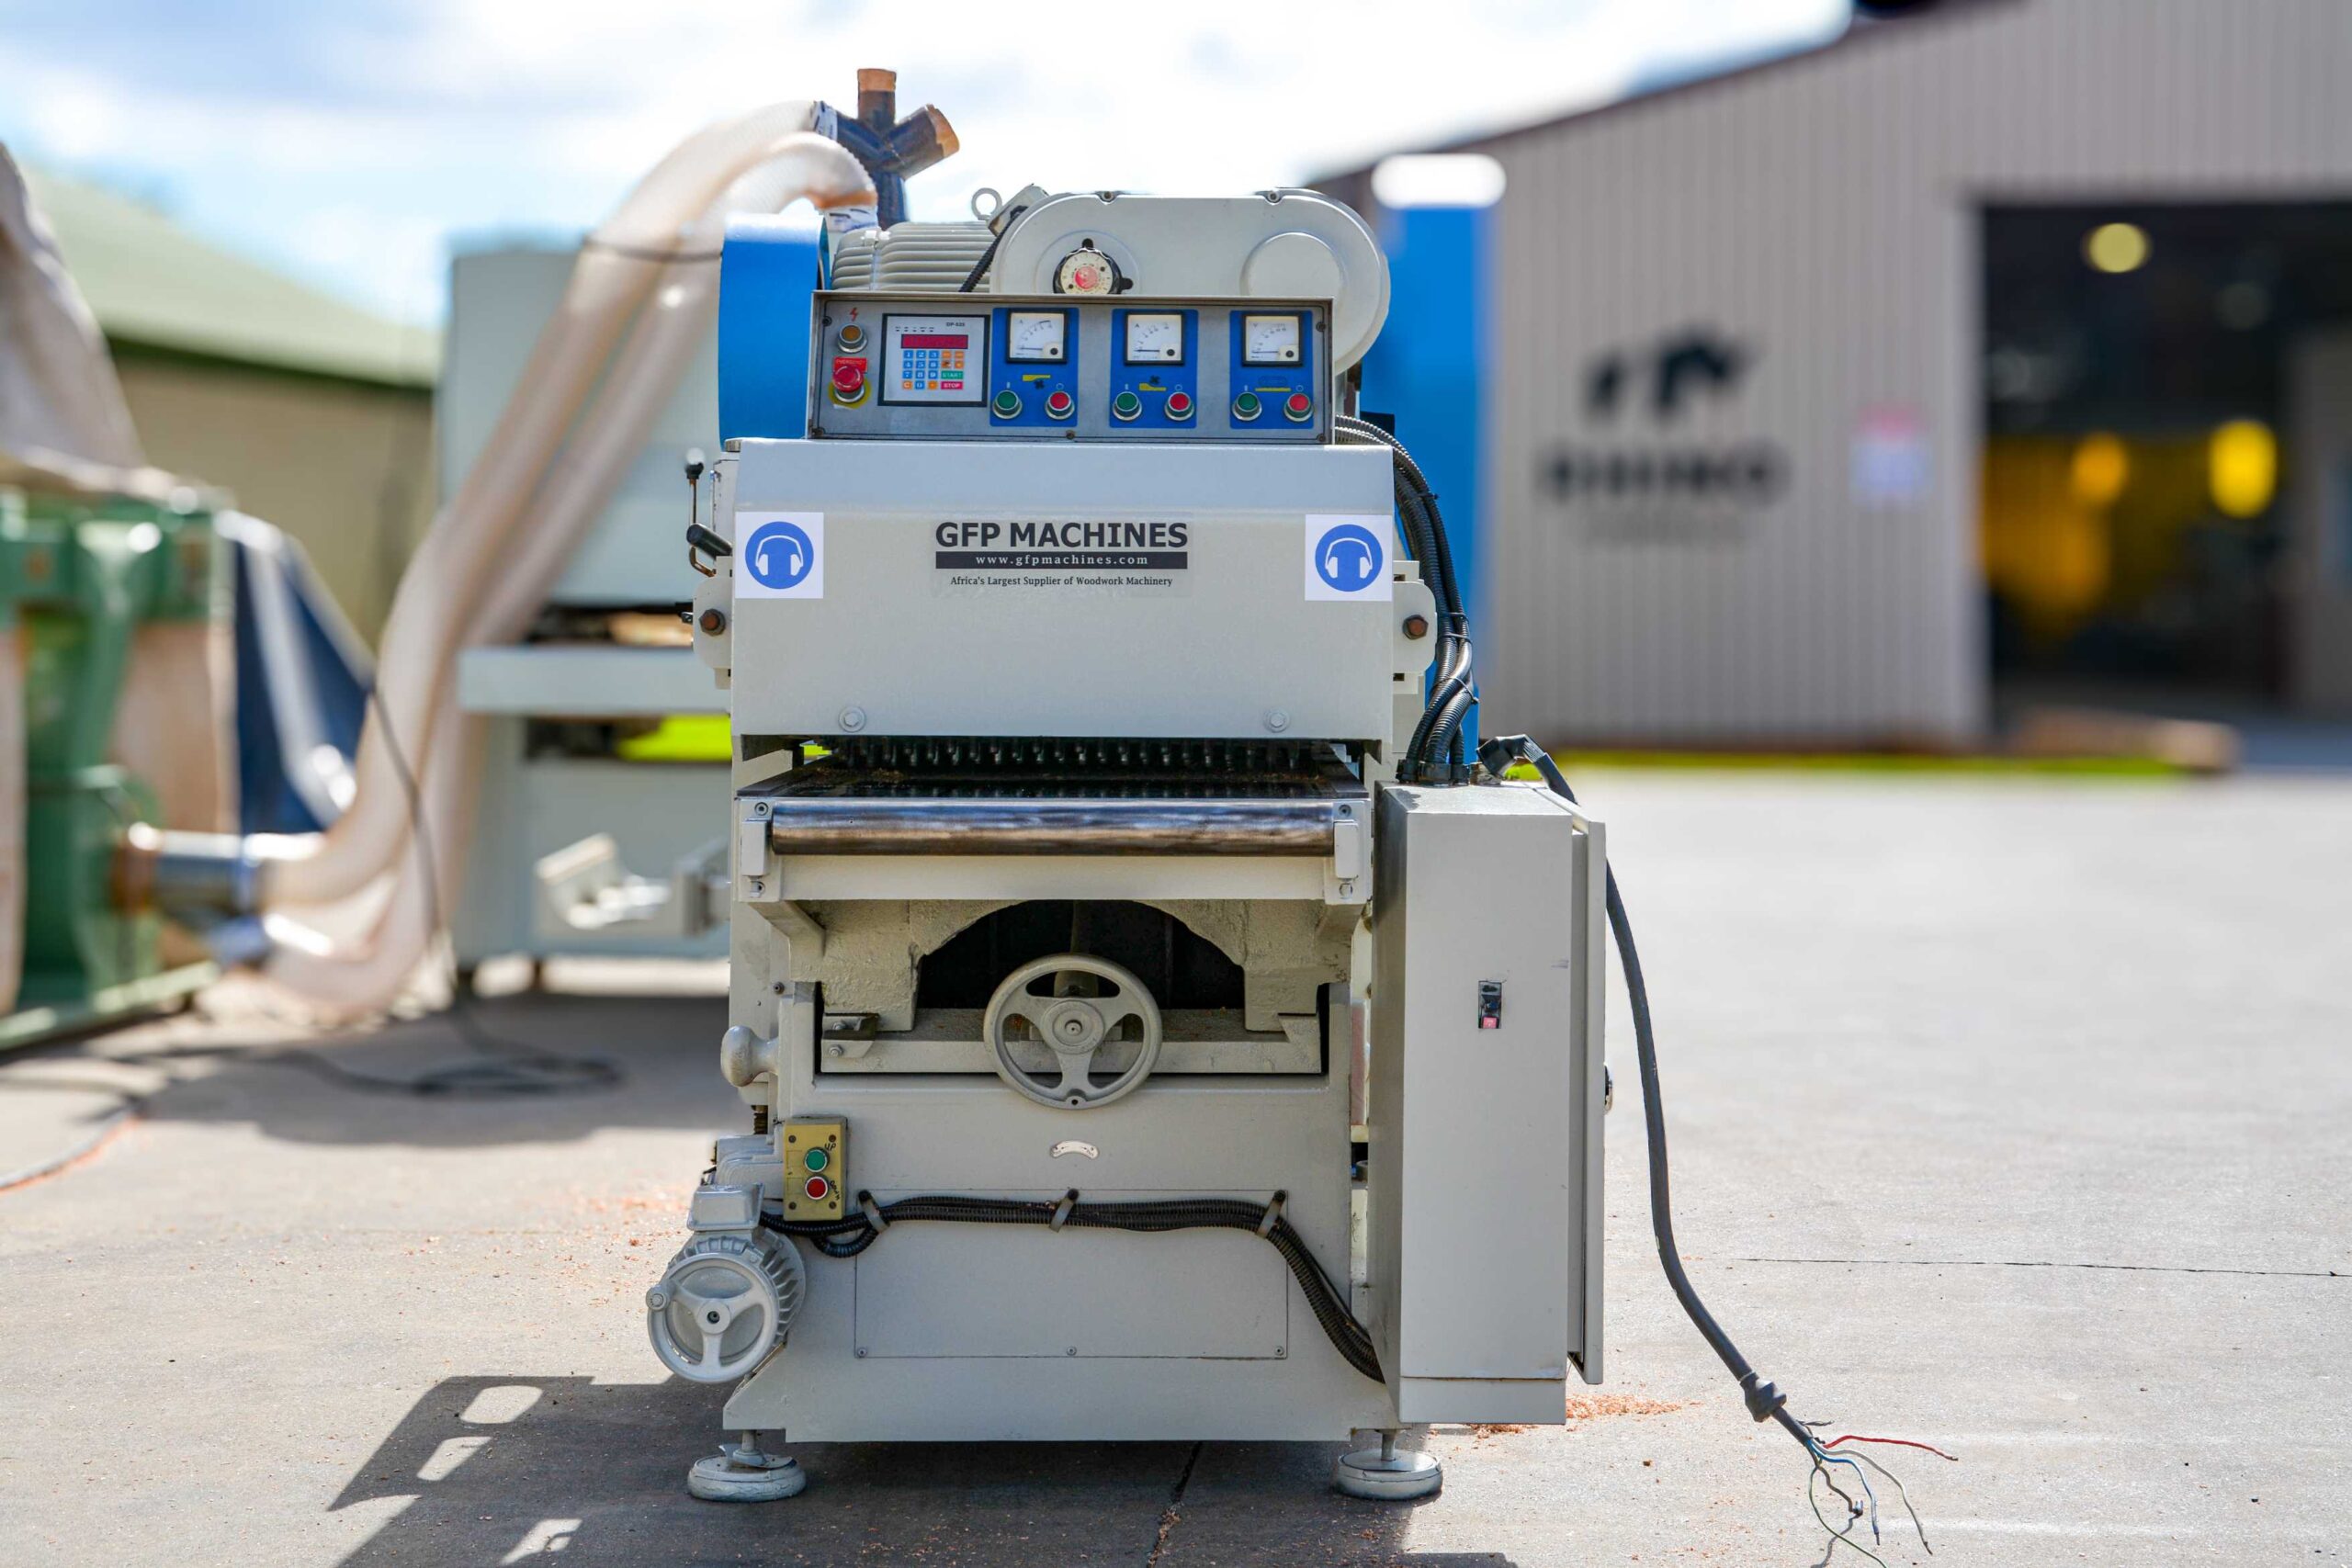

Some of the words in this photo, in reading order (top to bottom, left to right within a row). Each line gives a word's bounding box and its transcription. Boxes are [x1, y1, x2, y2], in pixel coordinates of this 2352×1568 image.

[935, 522, 1001, 547] GFP
[1010, 522, 1188, 548] MACHINES
[976, 554, 1148, 567] www.gfpmachines.com
[950, 576, 985, 585] Africa's
[988, 576, 1021, 587] Largest
[1023, 576, 1061, 587] Supplier
[1063, 576, 1074, 585] of
[1076, 576, 1125, 585] Woodwork
[1125, 576, 1173, 588] Machinery
[825, 1143, 837, 1152] UP
